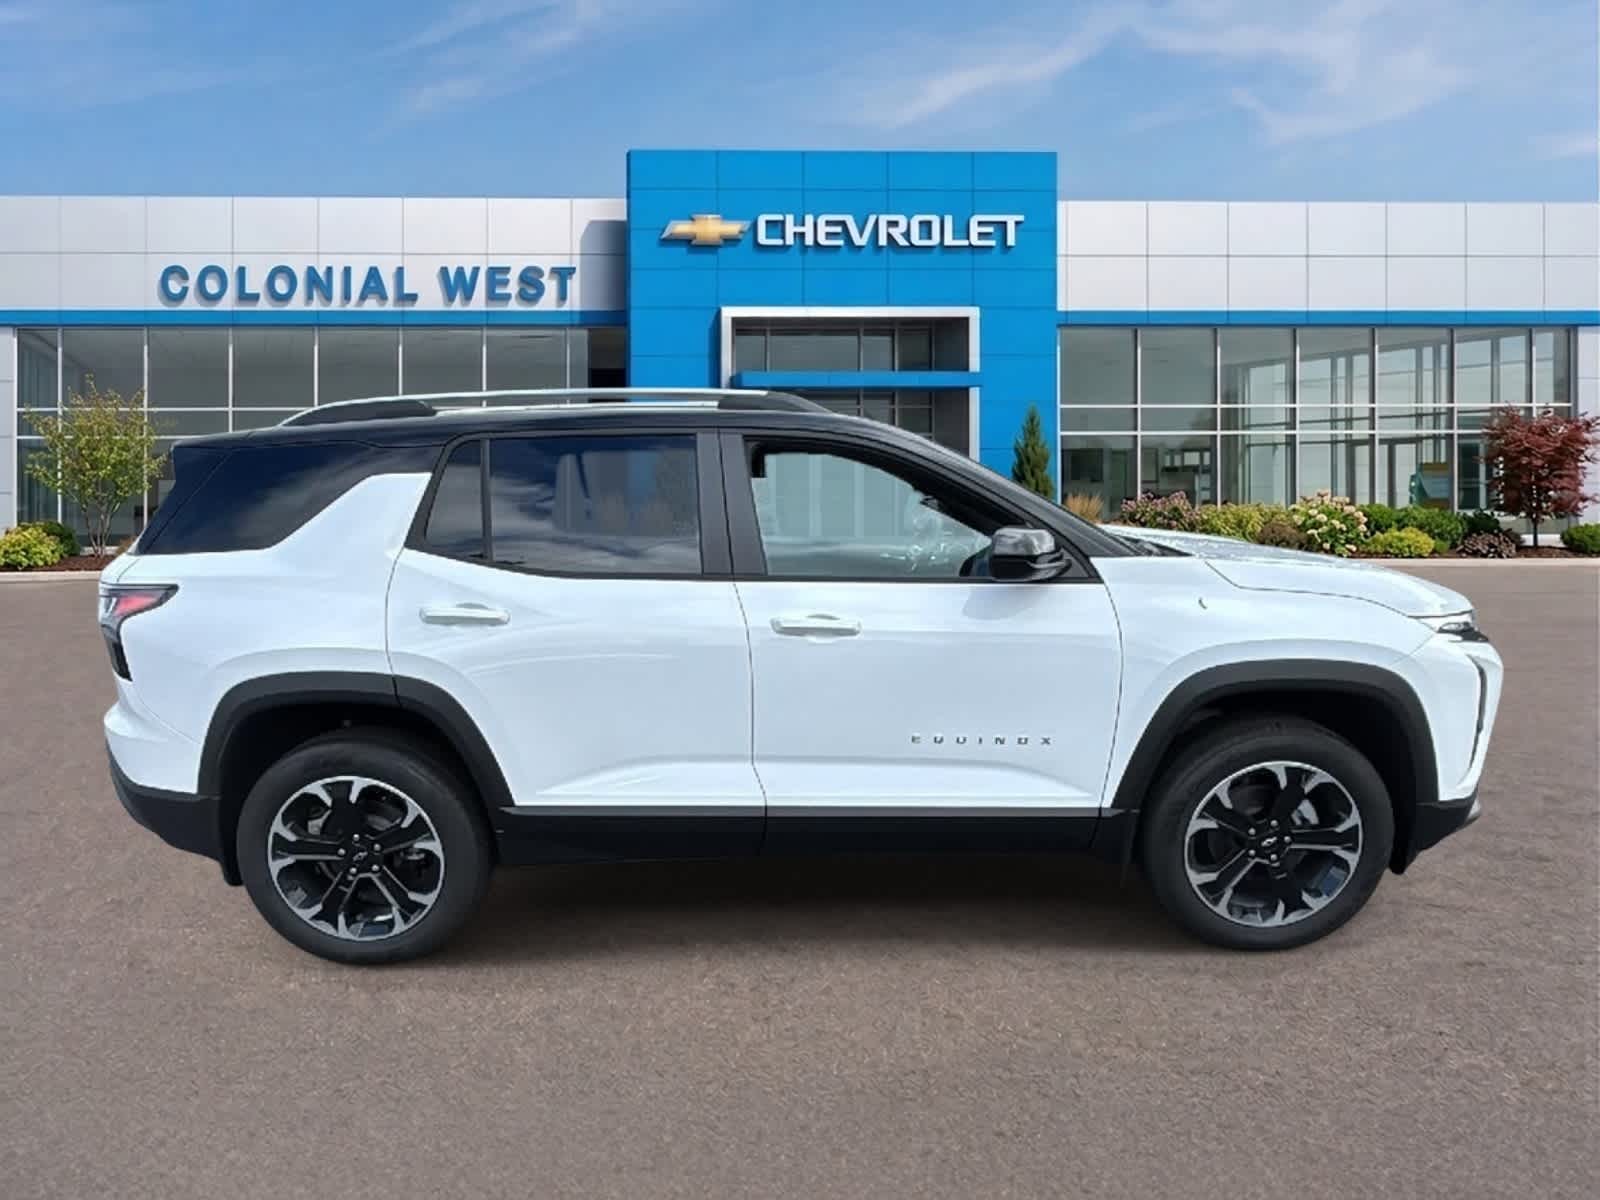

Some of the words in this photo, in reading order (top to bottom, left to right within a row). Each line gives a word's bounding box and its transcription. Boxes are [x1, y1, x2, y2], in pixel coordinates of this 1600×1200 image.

[757, 213, 1025, 247] CHEVROLET
[160, 264, 418, 302] COLONIAL
[438, 265, 577, 303] WEST
[911, 735, 1052, 746] EQUINOX
